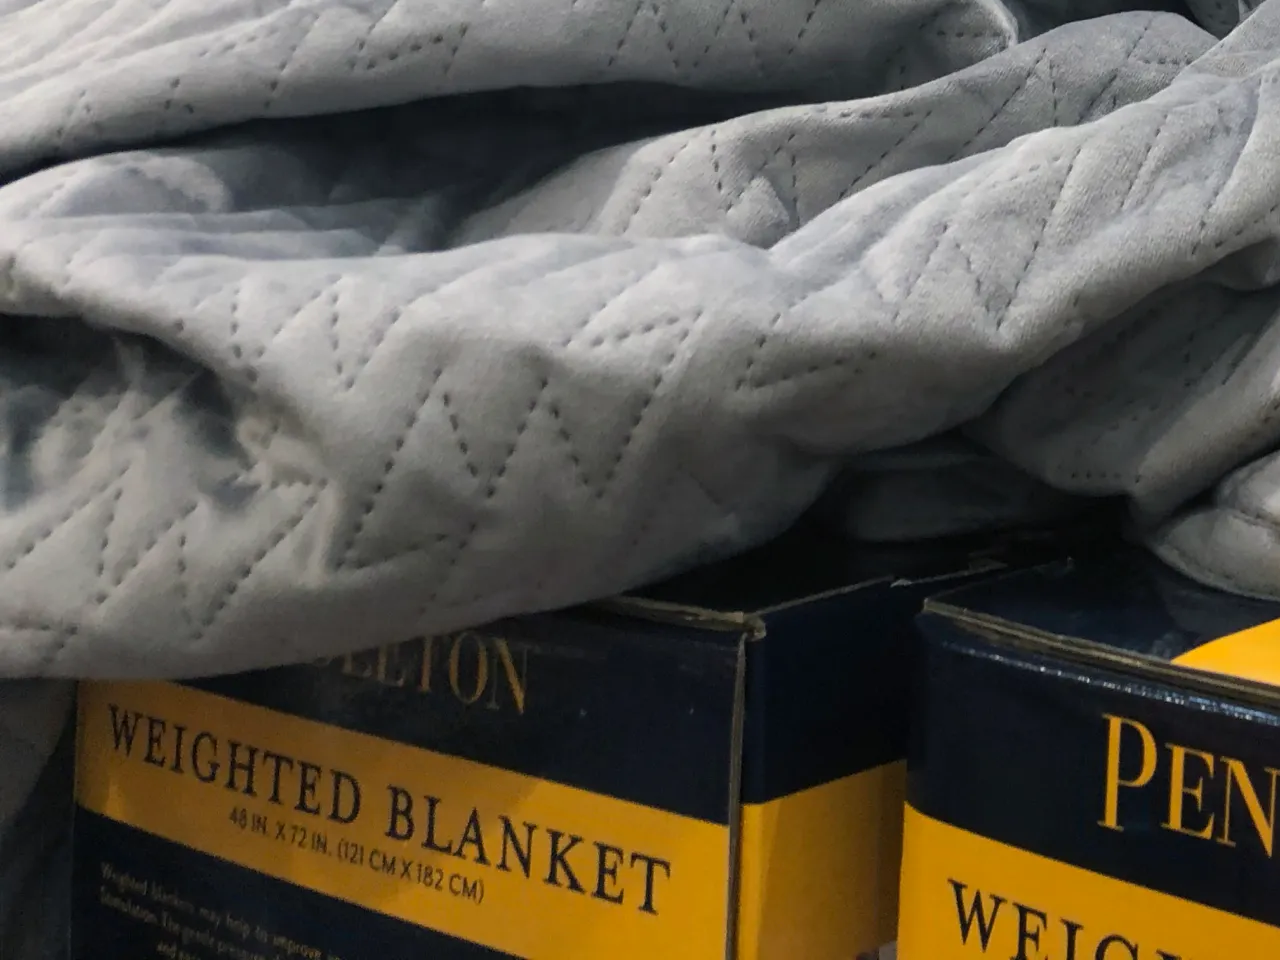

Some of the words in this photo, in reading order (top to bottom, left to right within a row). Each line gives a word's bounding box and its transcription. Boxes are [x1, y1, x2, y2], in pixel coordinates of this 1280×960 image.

[107, 704, 362, 824] WEIGHTED
[384, 784, 671, 915] BLANKET
[229, 805, 248, 830] 48
[275, 821, 286, 841] X
[291, 823, 307, 850] 72
[311, 834, 332, 857] IN.
[337, 838, 364, 867] (121
[369, 848, 397, 876] CM
[400, 858, 412, 881] X
[416, 863, 445, 891] 182
[449, 872, 484, 905] CM)
